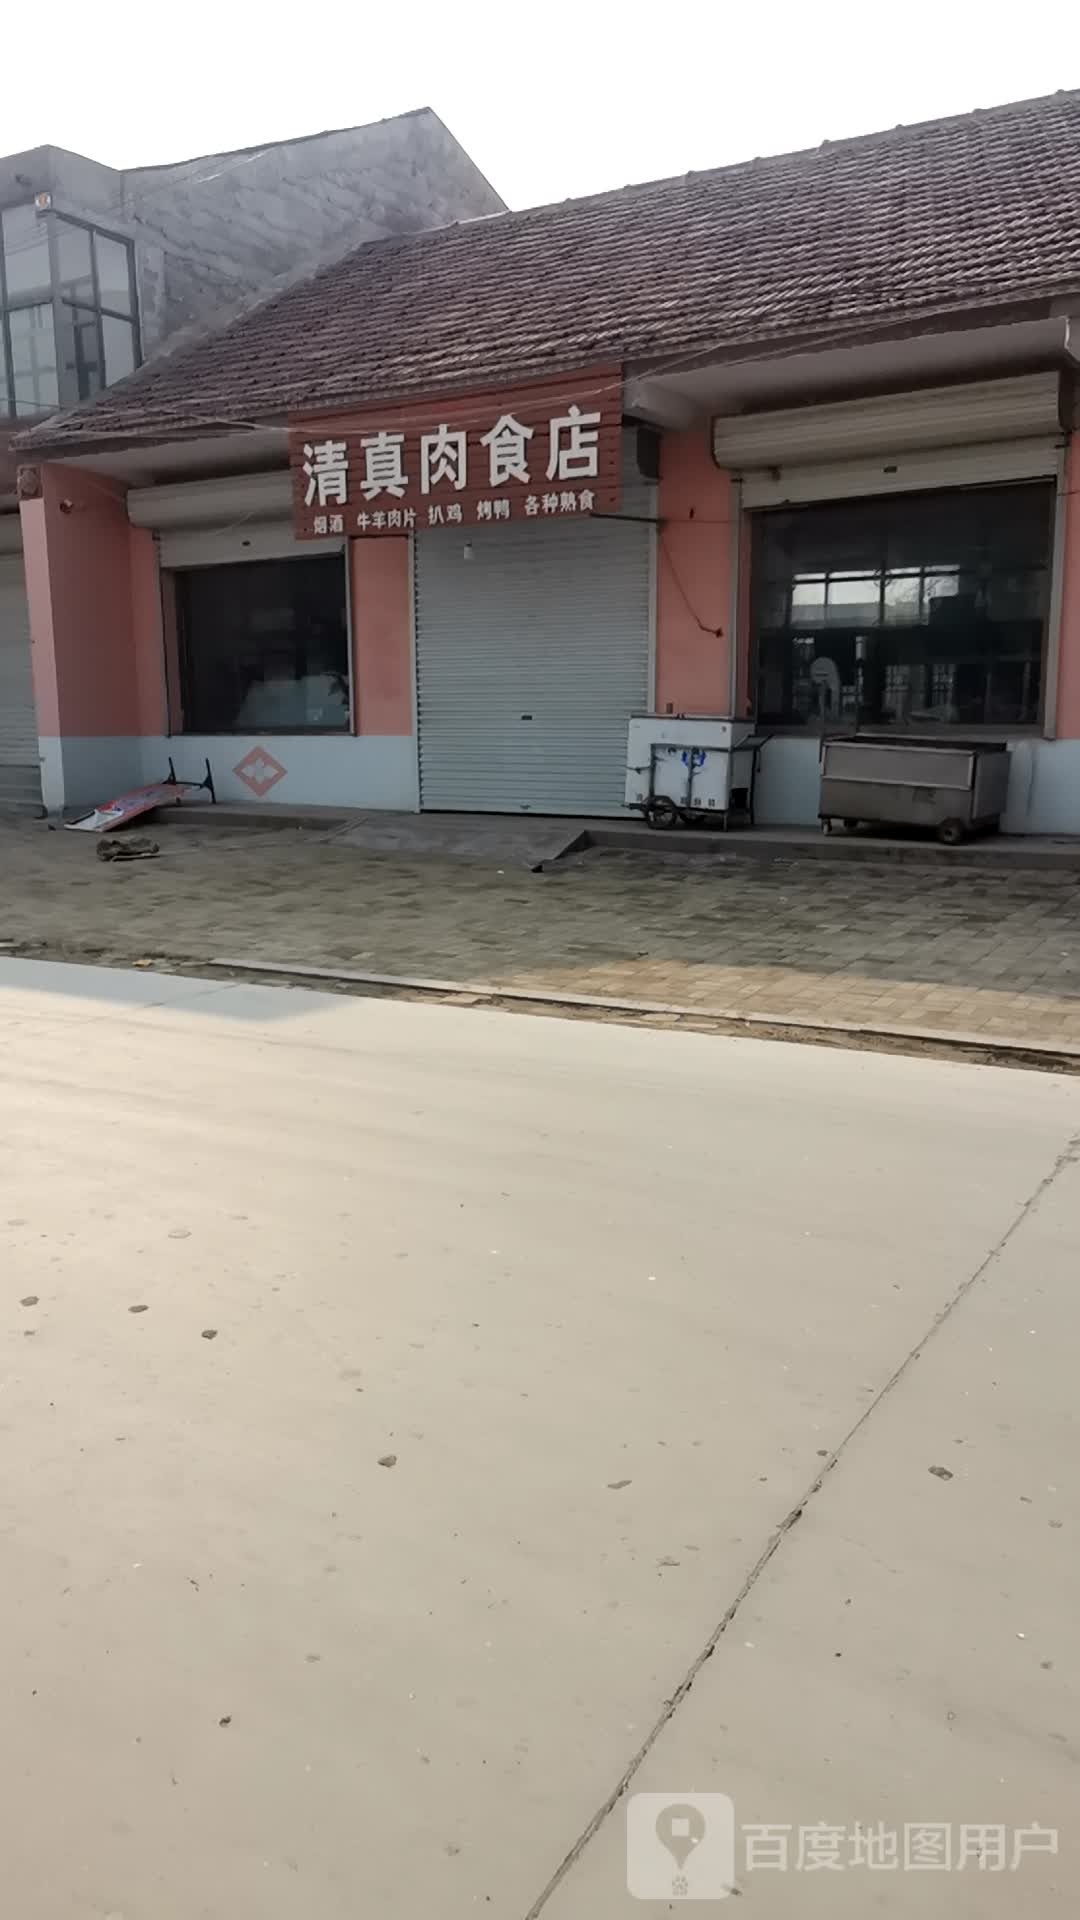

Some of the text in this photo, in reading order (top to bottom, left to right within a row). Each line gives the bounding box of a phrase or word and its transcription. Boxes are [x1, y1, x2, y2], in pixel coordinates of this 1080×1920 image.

[302, 404, 601, 507] 清真肉食店
[313, 489, 596, 534] 烟酒 牛羊肉片 扒鸡 烤鸭 各种熟食
